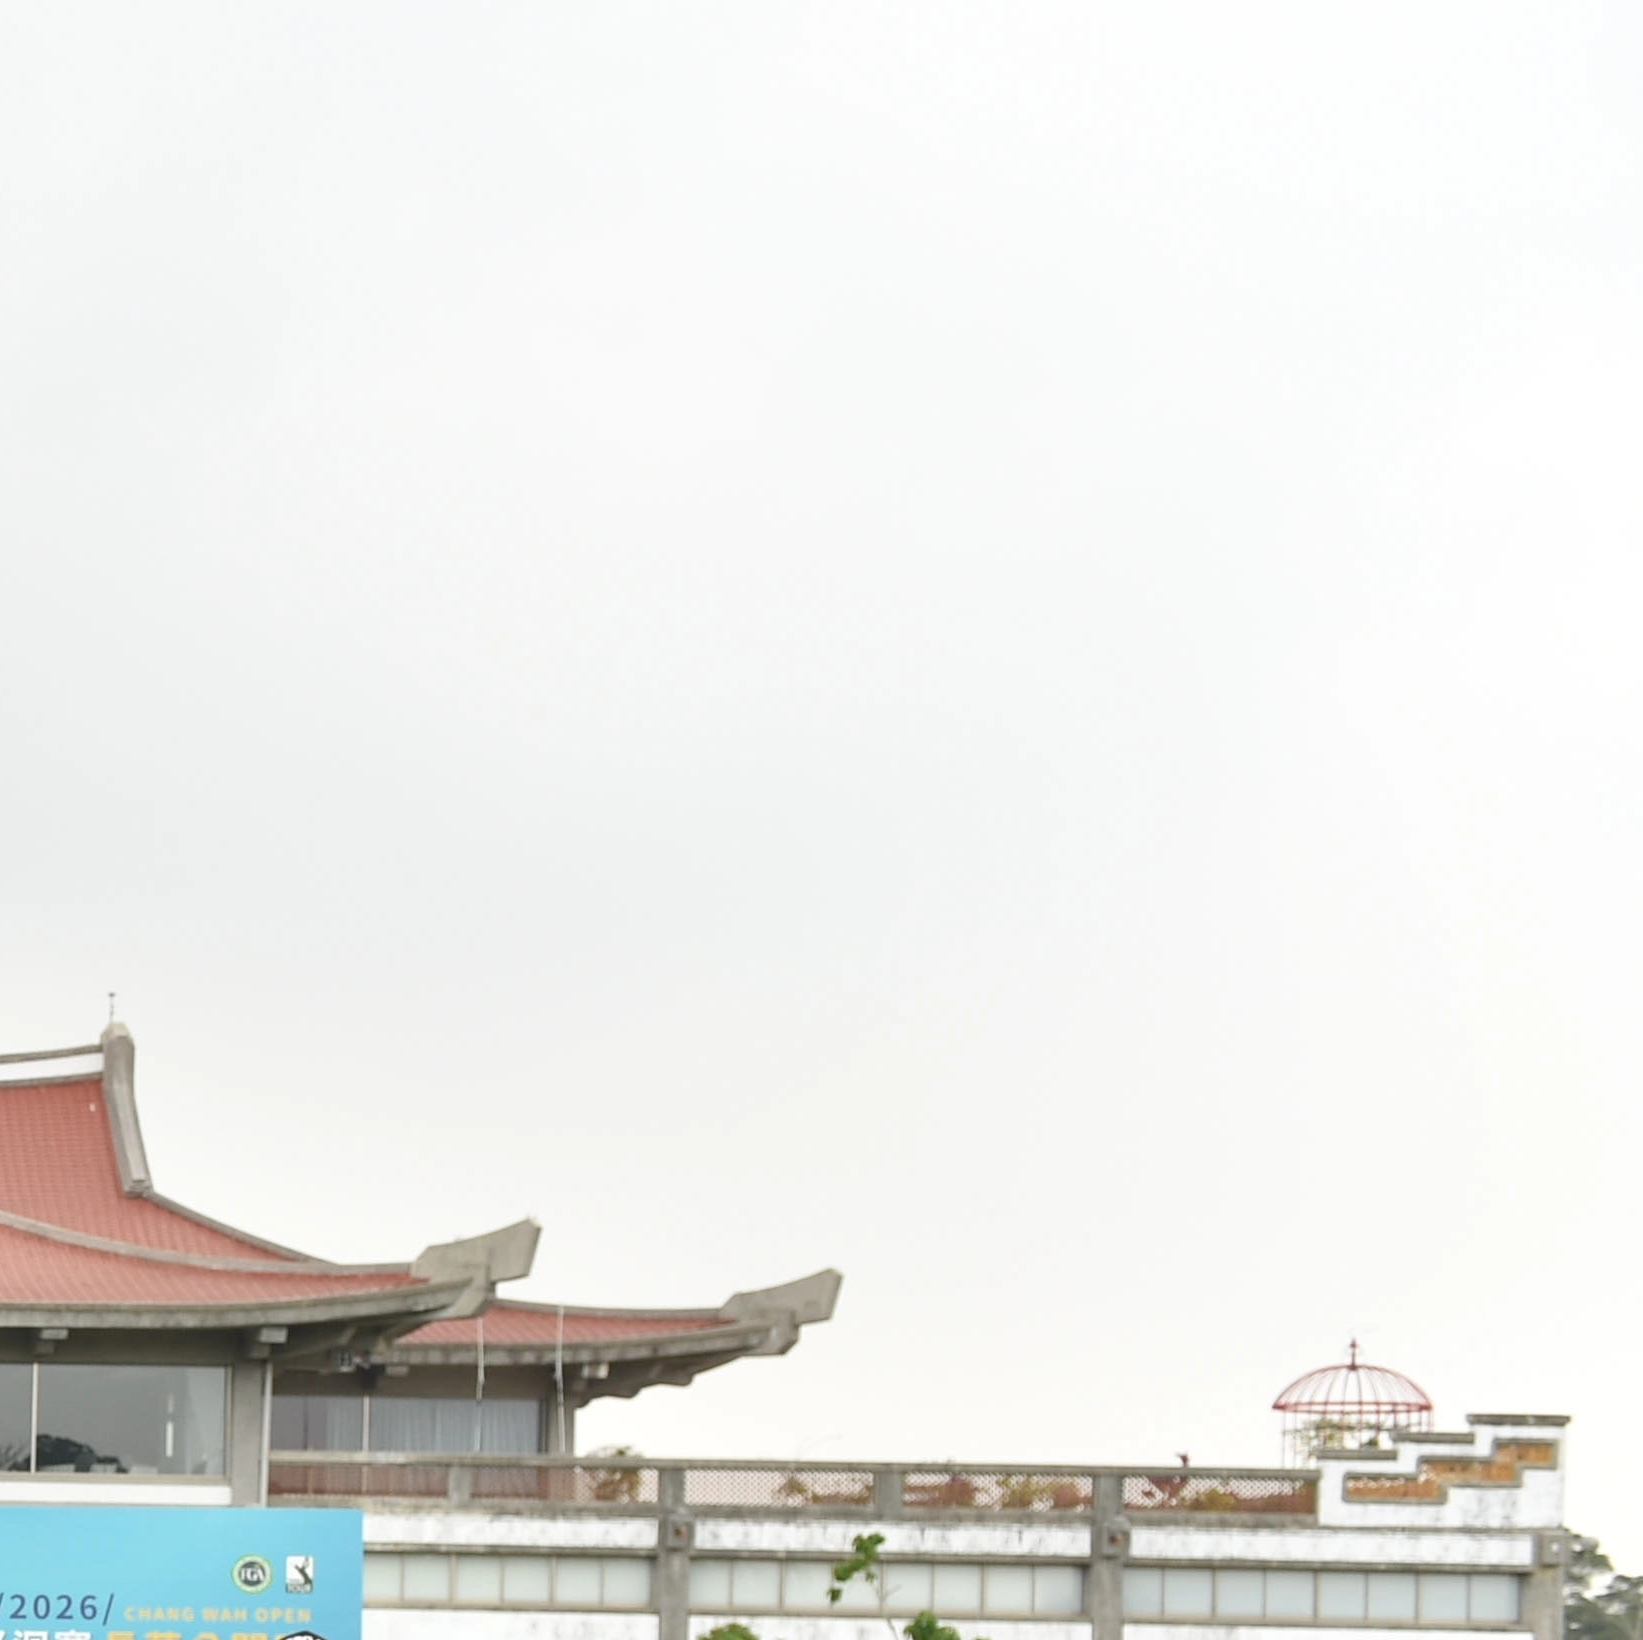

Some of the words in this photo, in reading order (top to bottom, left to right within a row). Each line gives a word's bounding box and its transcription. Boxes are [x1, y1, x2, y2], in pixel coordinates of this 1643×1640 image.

[124, 1606, 196, 1622] CHANG
[202, 1607, 249, 1622] WAH
[255, 1607, 312, 1623] OPEN
